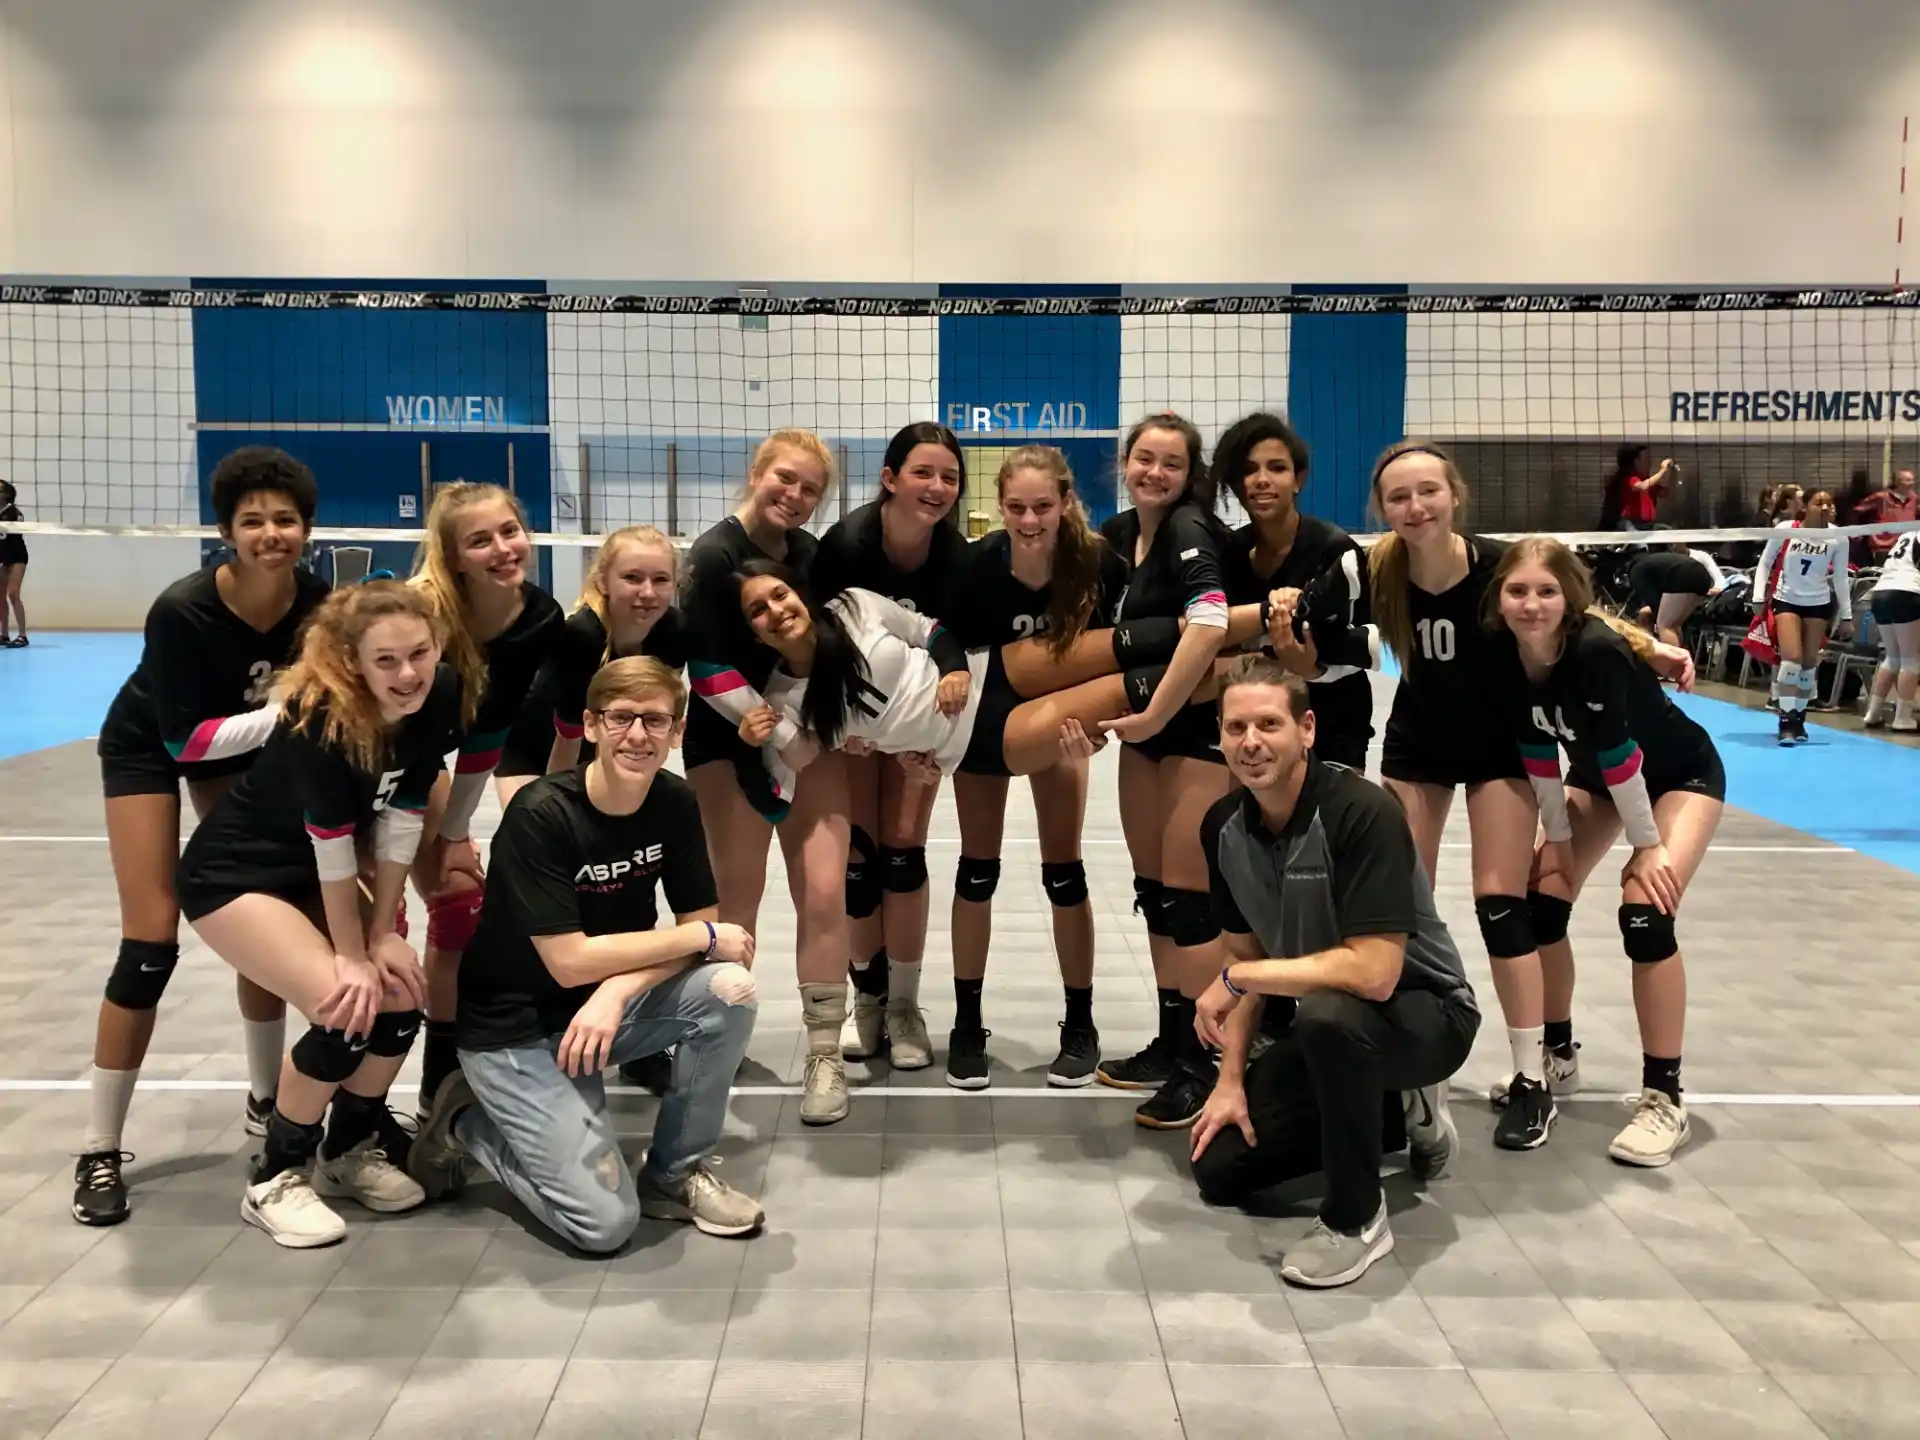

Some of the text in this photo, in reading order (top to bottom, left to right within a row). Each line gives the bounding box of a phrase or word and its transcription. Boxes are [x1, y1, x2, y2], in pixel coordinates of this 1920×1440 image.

[386, 396, 504, 424] WOMEN
[947, 402, 1087, 431] FIRST AID
[1671, 390, 1920, 422] REFRESHMENTS
[1800, 558, 1812, 576] 7
[1416, 618, 1455, 661] 10
[1532, 704, 1576, 741] 44
[373, 769, 404, 811] 5
[574, 843, 663, 882] ASPRE
